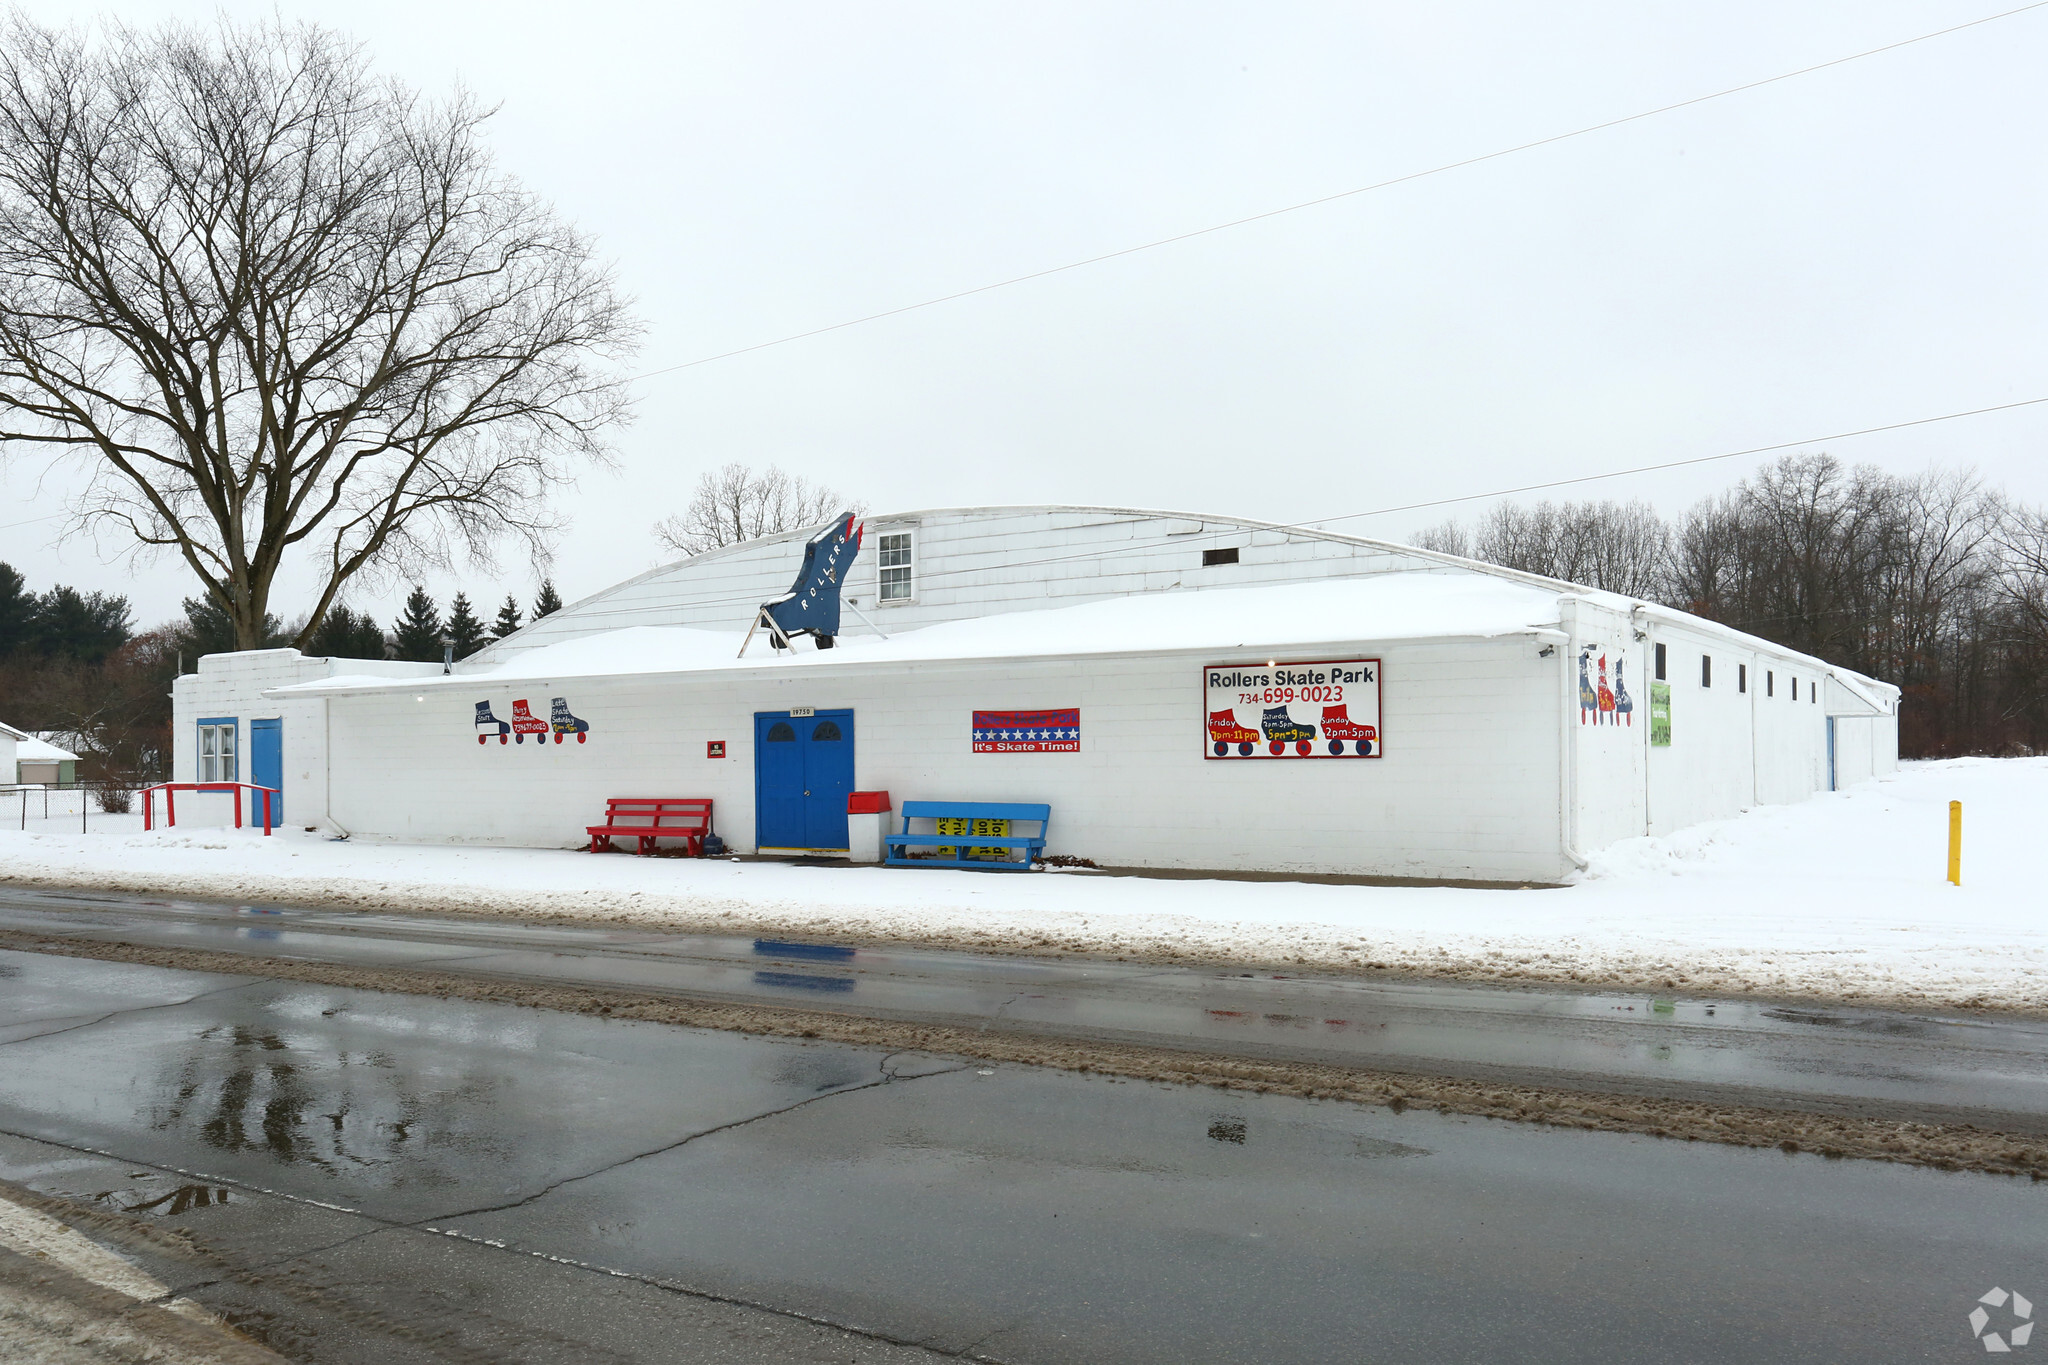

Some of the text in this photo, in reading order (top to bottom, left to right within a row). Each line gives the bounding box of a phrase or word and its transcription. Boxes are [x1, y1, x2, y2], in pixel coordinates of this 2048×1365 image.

[801, 534, 846, 610] ROLLERS
[1209, 667, 1374, 688] Rollers Skate Park
[1239, 686, 1343, 704] 734-699-0023
[974, 710, 1079, 725] Rollers Skate Park
[1209, 718, 1236, 729] Friday
[1321, 717, 1350, 726] Sunday
[1325, 728, 1374, 738] 2pm-5pm
[974, 742, 1078, 751] It's Skate Time!
